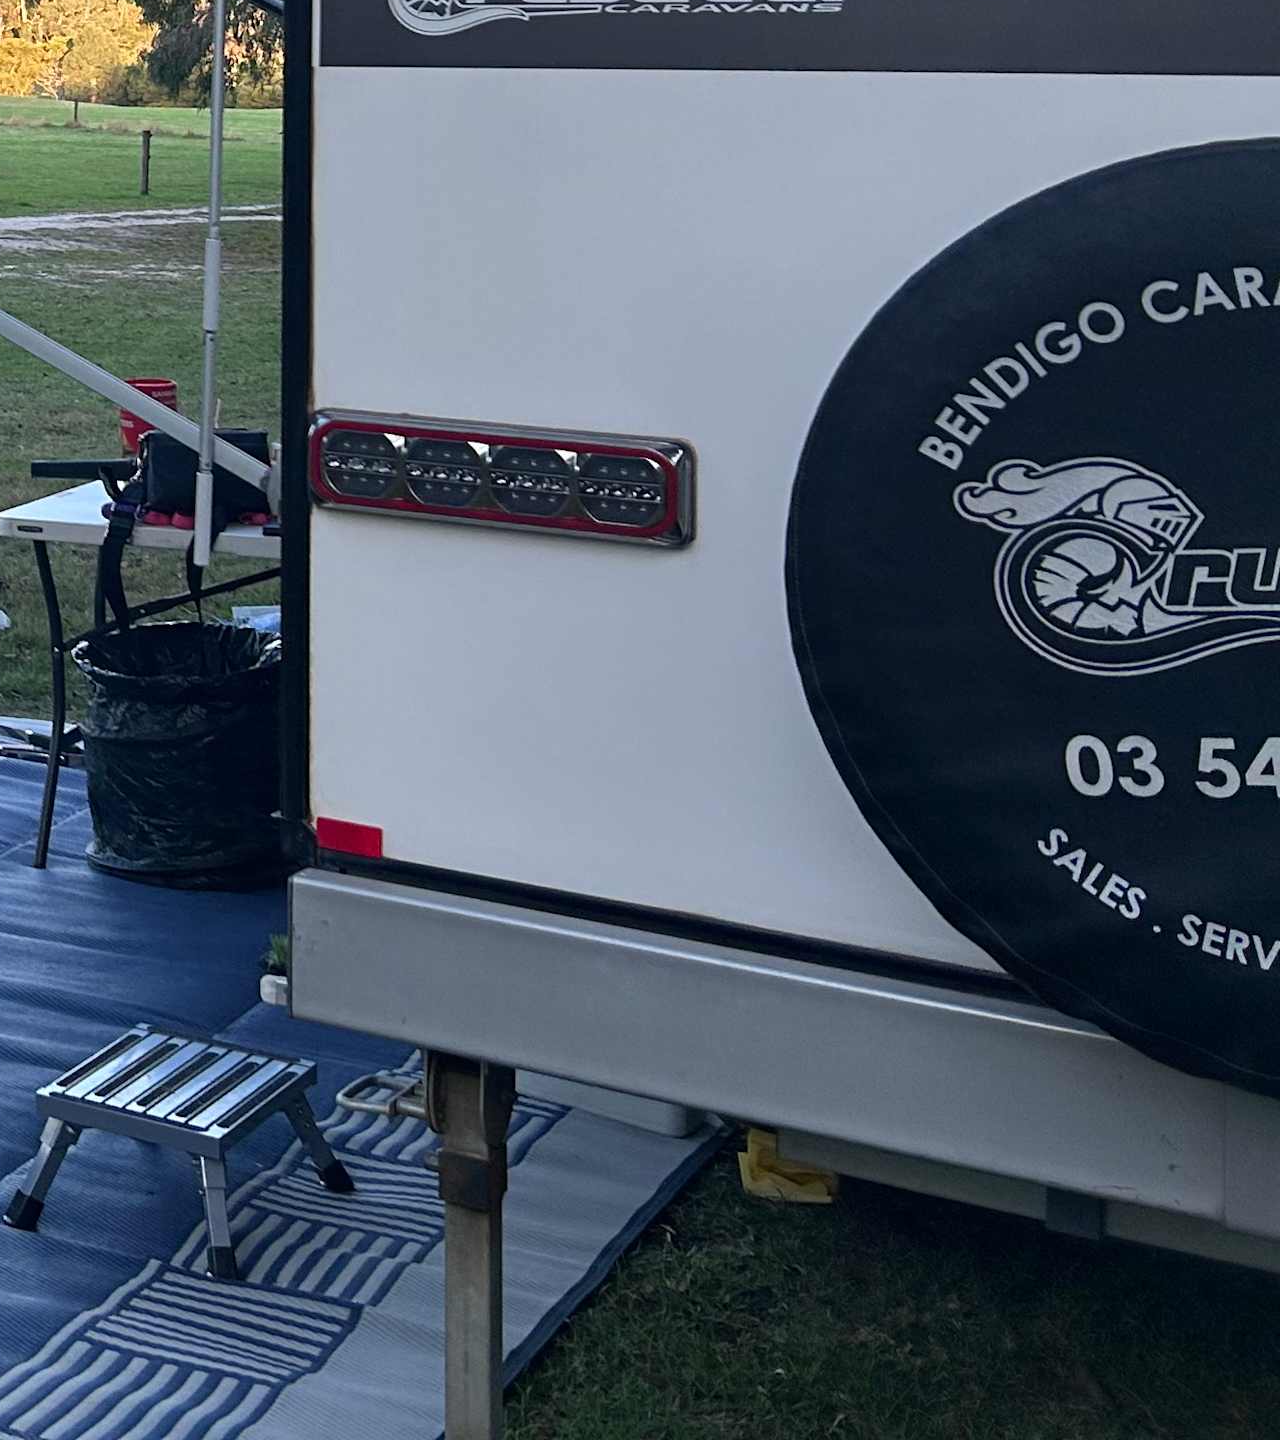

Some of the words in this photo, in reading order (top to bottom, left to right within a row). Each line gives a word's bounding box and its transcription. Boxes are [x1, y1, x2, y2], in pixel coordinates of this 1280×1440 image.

[601, 2, 844, 14] CARAVANS
[918, 301, 1126, 471] BENDIGO
[1141, 266, 1280, 323] CAR
[1065, 734, 1165, 797] 03
[1195, 736, 1280, 799] 54
[1037, 828, 1147, 920] SALES
[1176, 914, 1280, 971] SERV
